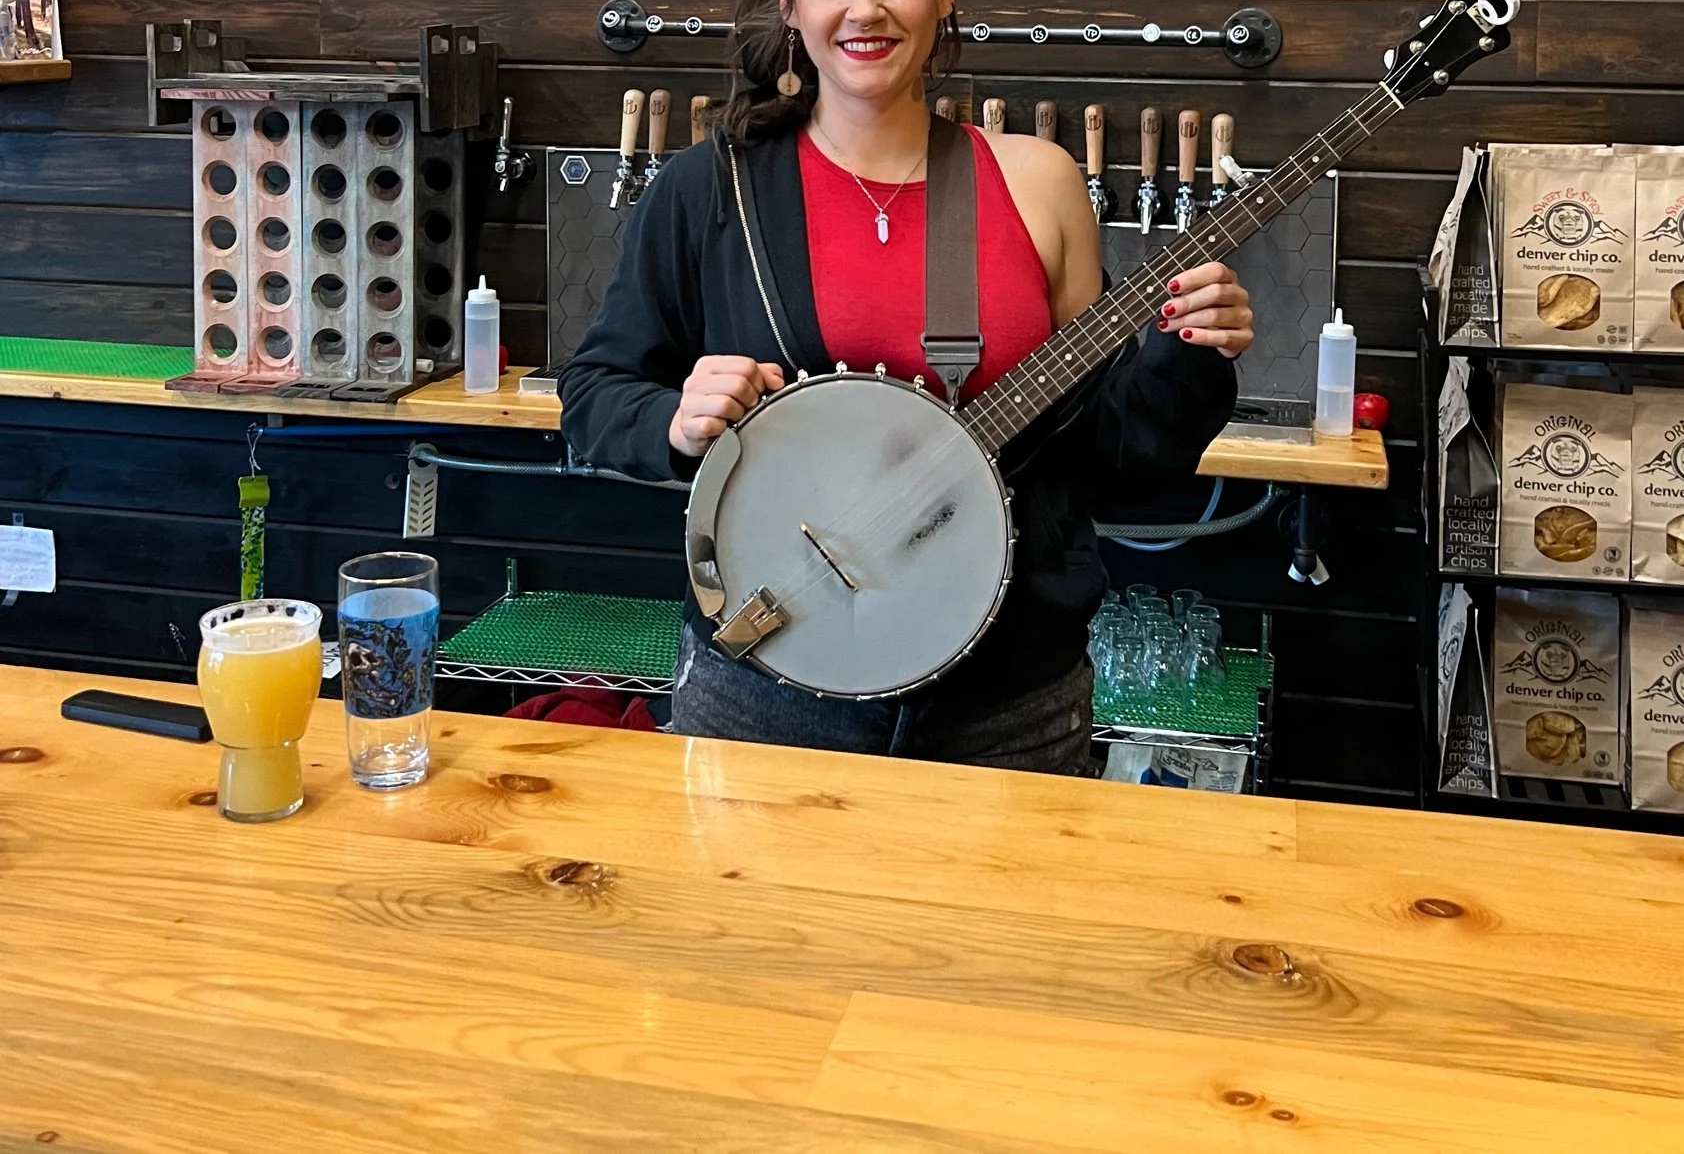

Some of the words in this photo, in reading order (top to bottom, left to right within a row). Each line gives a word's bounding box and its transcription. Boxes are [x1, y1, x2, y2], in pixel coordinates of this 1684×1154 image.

[1517, 246, 1566, 261] denver
[1569, 249, 1598, 265] chip
[1601, 253, 1622, 263] co.
[1457, 265, 1483, 275] hand
[1452, 276, 1491, 289] crafted
[1453, 302, 1488, 314] made
[1514, 476, 1563, 492] denver
[1566, 480, 1595, 498] chip
[1598, 486, 1618, 497] co.
[1453, 494, 1489, 507] hand
[1446, 508, 1495, 519] crafted
[1448, 518, 1492, 533] locally
[1449, 532, 1489, 544] made
[1450, 555, 1487, 569] chips
[1506, 682, 1553, 698] denver
[1556, 687, 1584, 703] chip
[1586, 692, 1606, 702] co.
[1449, 752, 1485, 765] made
[1448, 776, 1484, 790] chips
